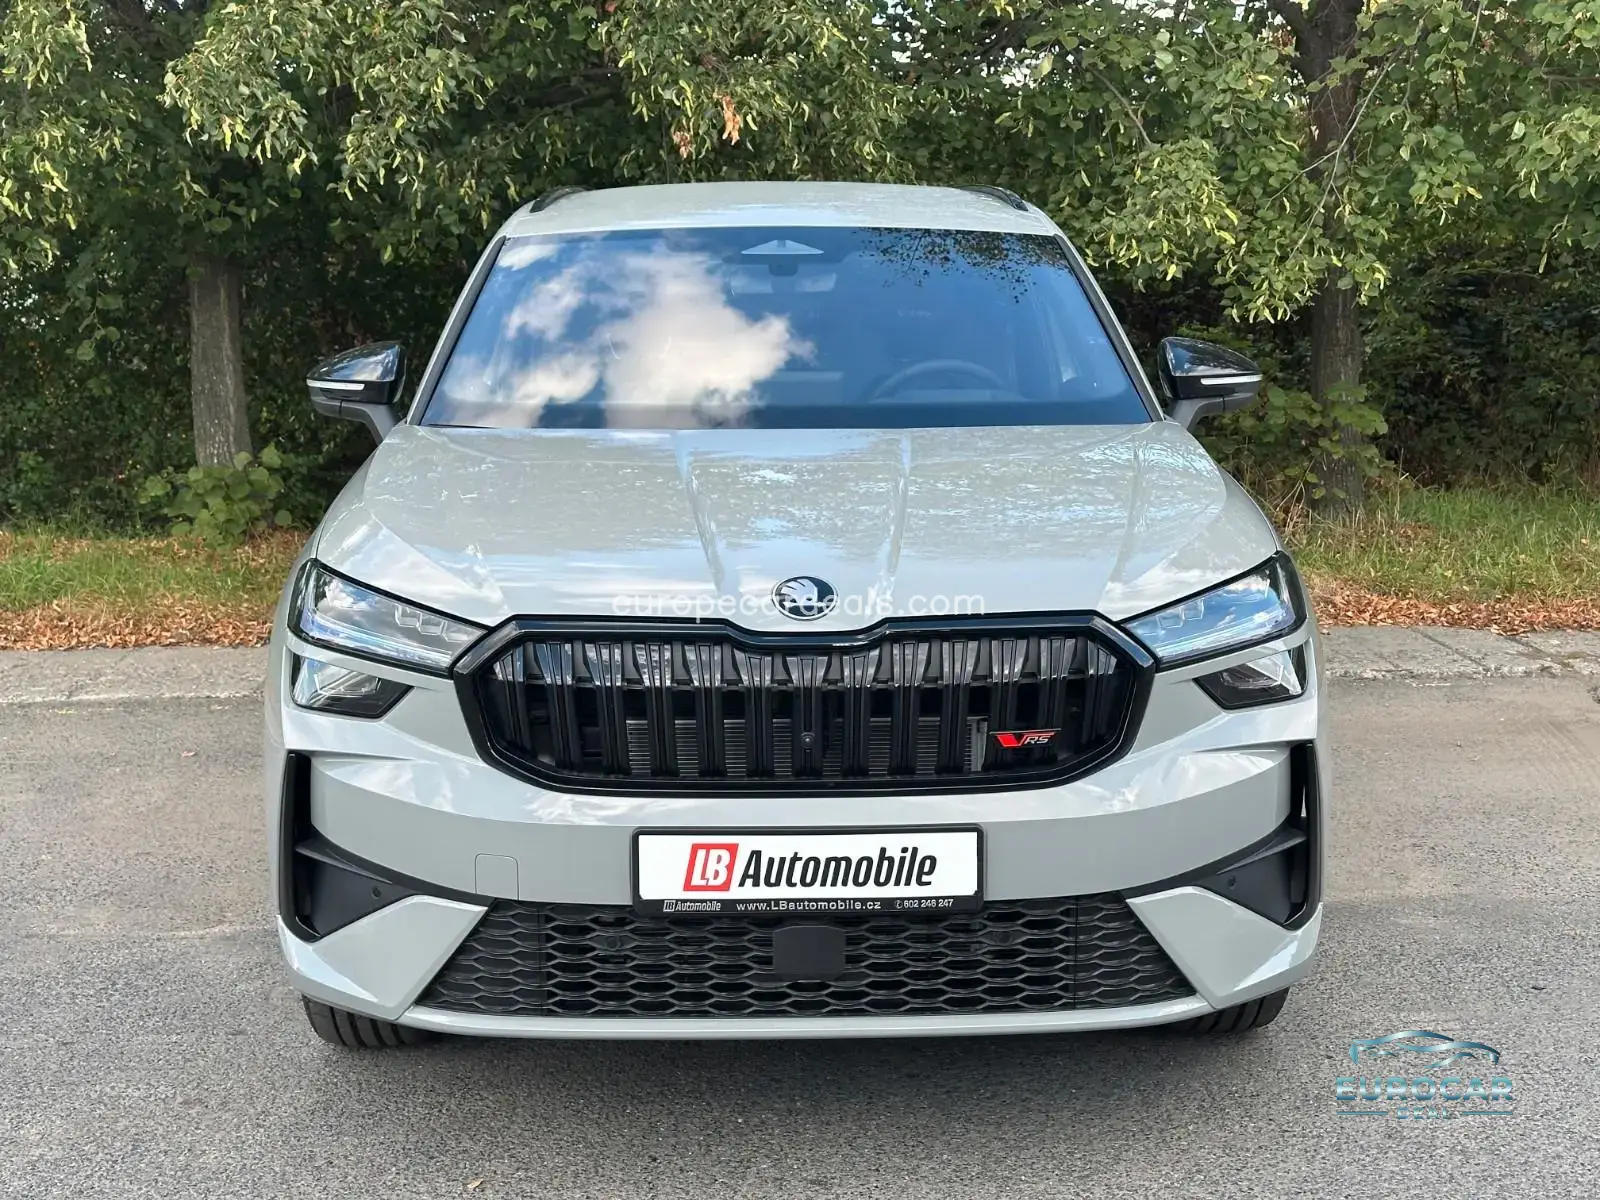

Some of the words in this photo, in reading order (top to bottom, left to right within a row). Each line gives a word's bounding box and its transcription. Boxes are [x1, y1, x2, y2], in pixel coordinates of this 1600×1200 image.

[689, 848, 733, 888] LB
[738, 846, 937, 889] Automobile
[675, 901, 722, 911] Automobile
[736, 899, 882, 911] www.LBautomobile.cz
[903, 899, 919, 909] 602
[938, 898, 954, 908] 247
